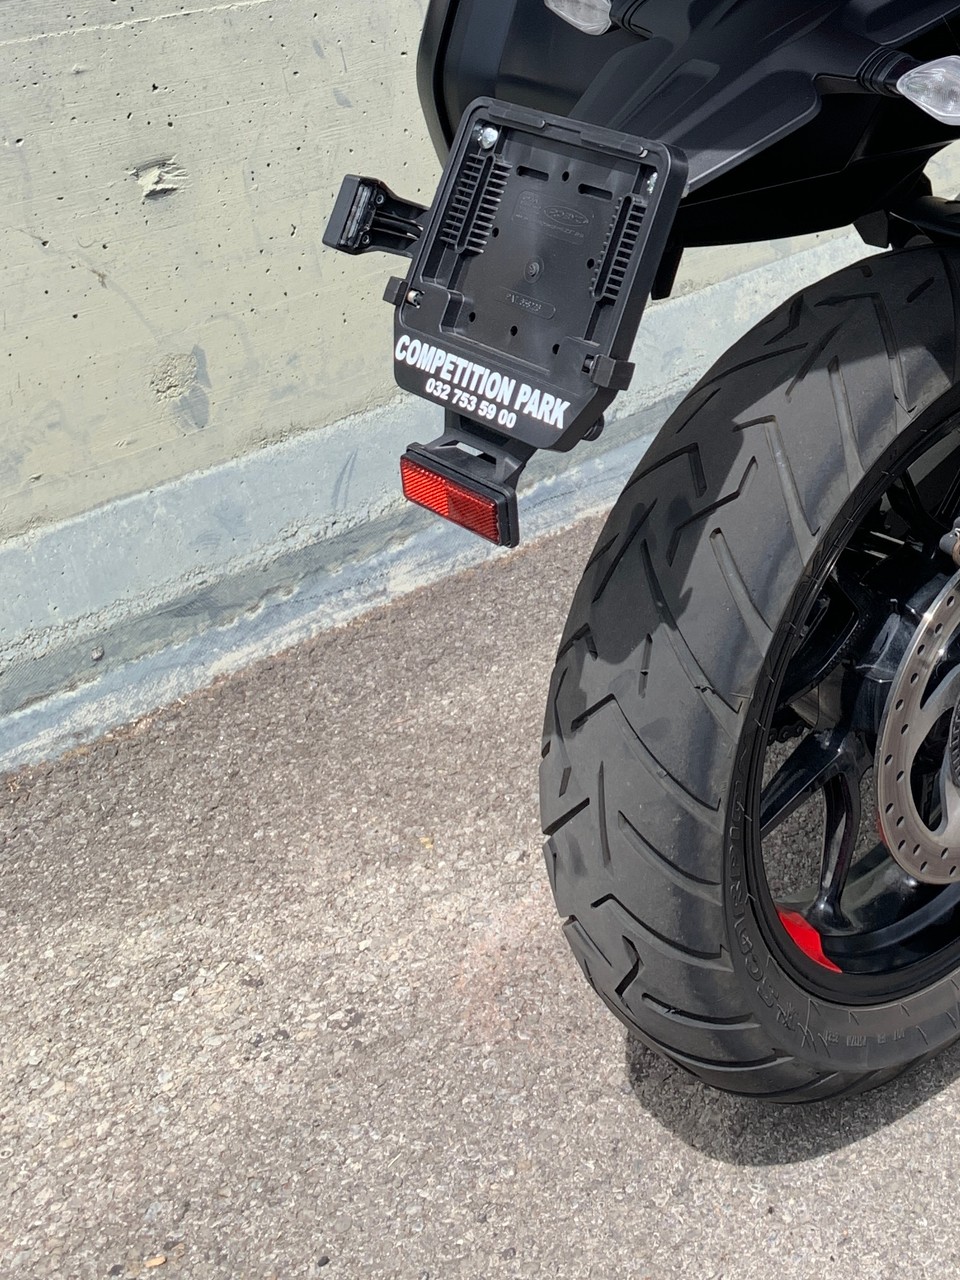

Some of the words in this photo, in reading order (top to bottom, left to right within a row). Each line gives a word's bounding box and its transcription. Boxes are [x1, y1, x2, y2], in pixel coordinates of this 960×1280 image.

[394, 334, 517, 406] COMPETITION
[514, 382, 571, 429] PARK
[425, 377, 452, 401] 032
[451, 388, 477, 412] 753
[477, 400, 498, 420] 59
[497, 410, 518, 429] 00
